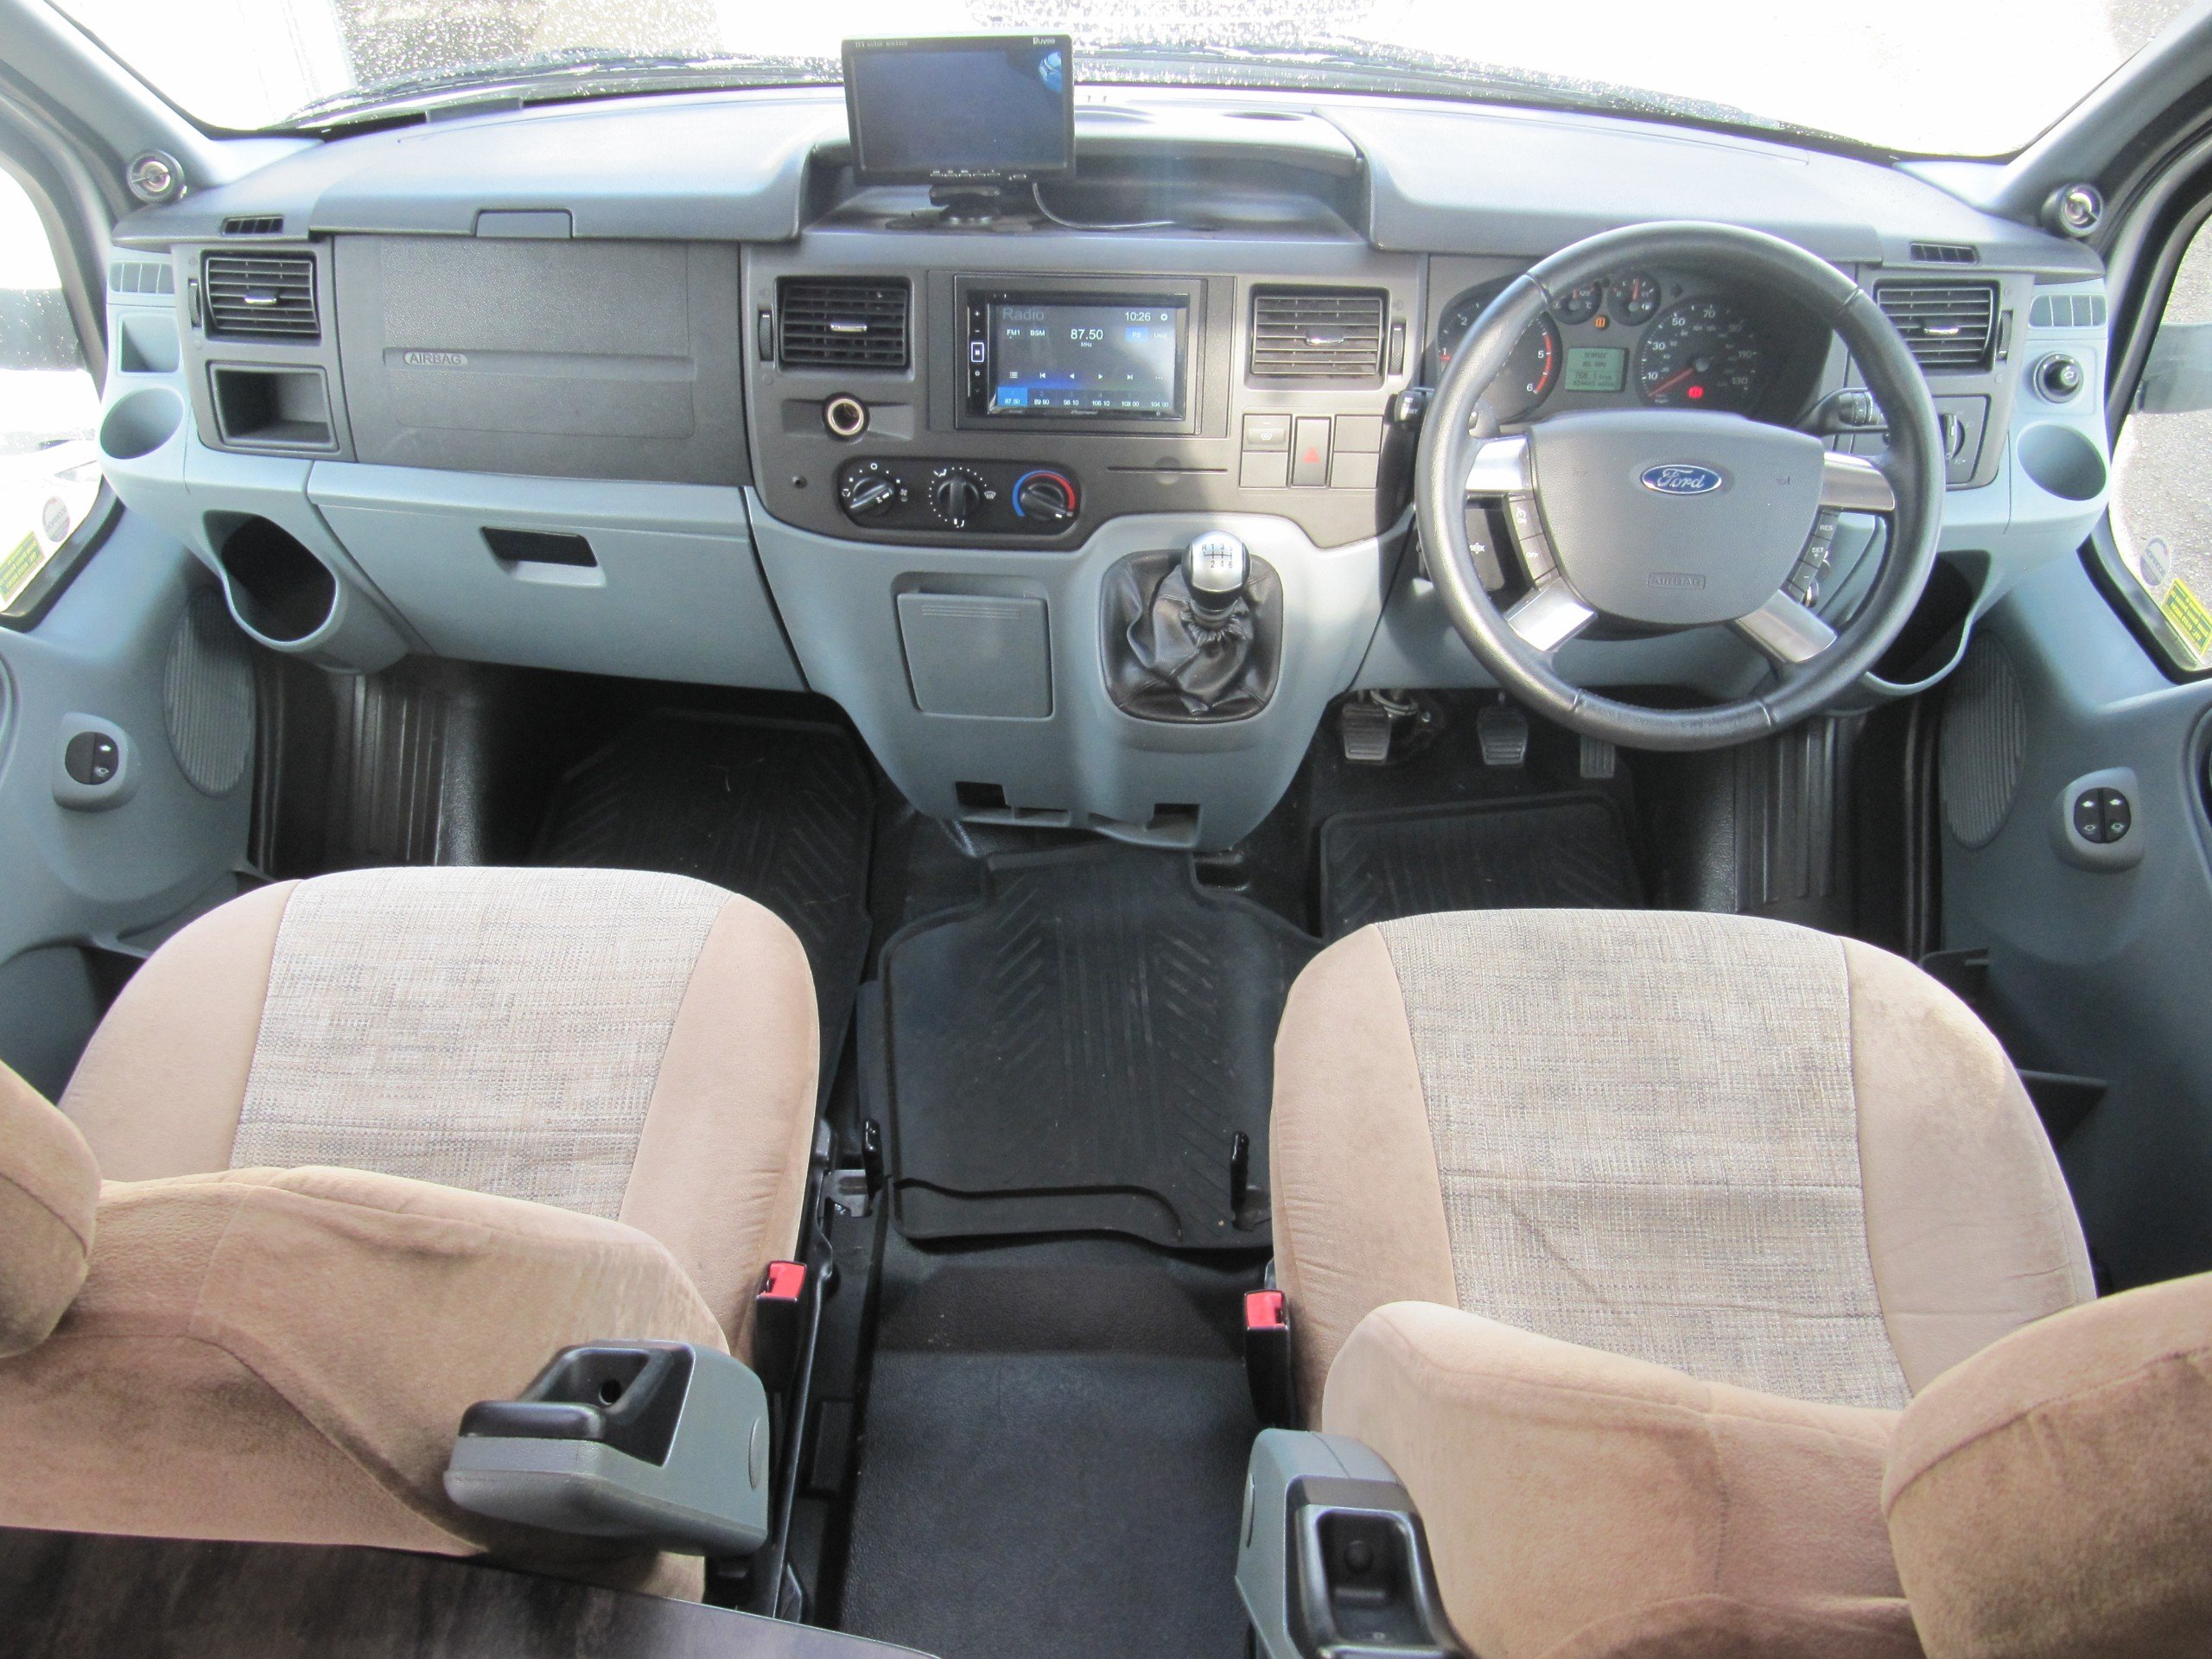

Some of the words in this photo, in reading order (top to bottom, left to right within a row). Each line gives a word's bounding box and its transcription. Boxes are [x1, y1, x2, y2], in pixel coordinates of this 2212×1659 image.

[1002, 307, 1045, 321] Radio
[1125, 311, 1151, 321] 10:26
[1702, 309, 1715, 318] 70
[1460, 316, 1468, 326] 2
[1672, 317, 1686, 326] 50
[1071, 328, 1103, 340] 87.50
[1652, 341, 1666, 351] 30
[410, 353, 461, 365] AIRBAG
[1537, 350, 1544, 359] 5
[1647, 372, 1658, 380] 10
[1526, 383, 1534, 391] 6
[1657, 467, 1706, 488] Ford
[1210, 560, 1216, 569] 2
[1228, 560, 1234, 569] 6
[1653, 575, 1701, 587] AIRBAG
